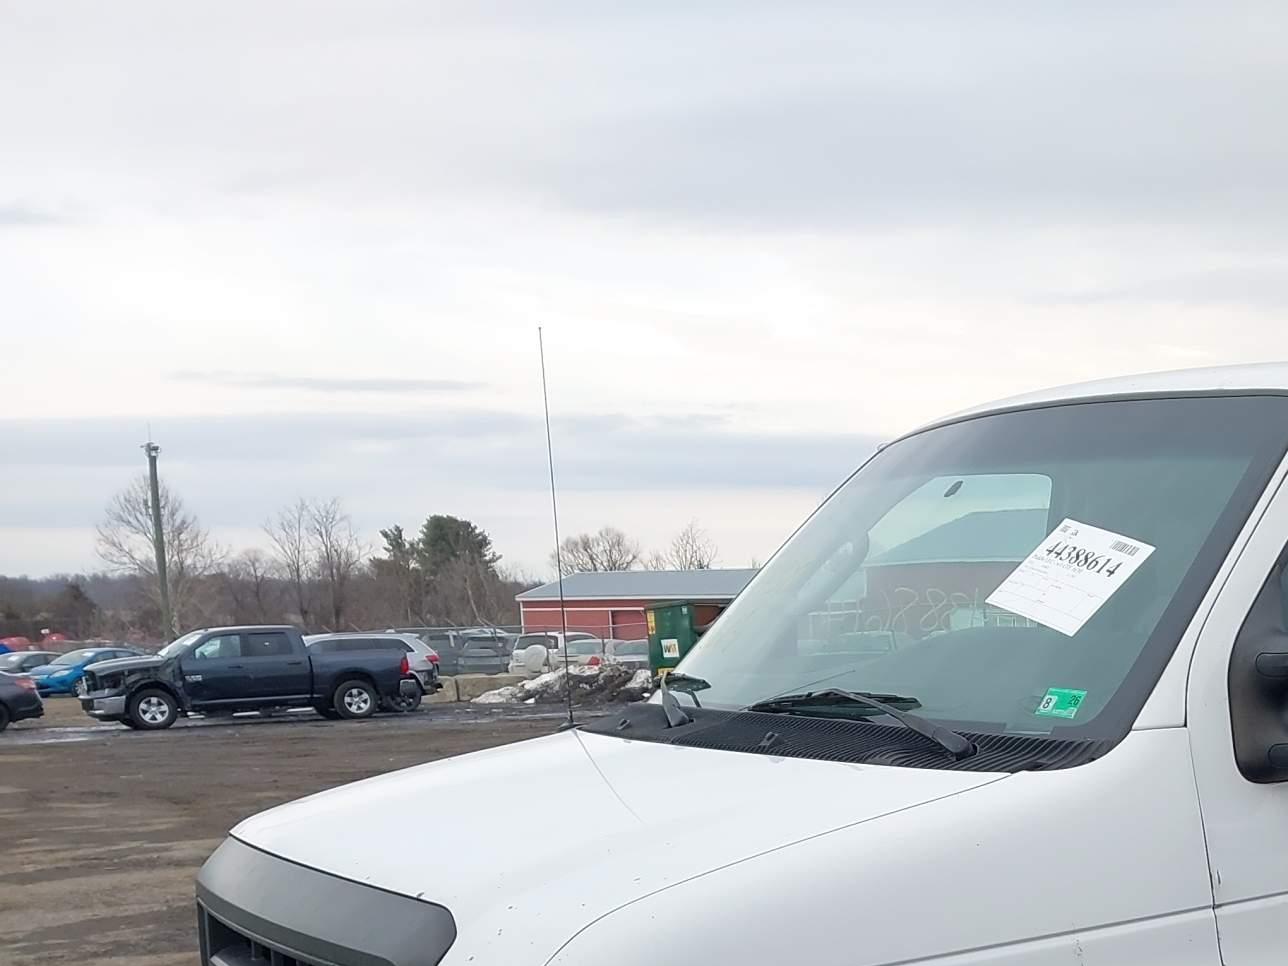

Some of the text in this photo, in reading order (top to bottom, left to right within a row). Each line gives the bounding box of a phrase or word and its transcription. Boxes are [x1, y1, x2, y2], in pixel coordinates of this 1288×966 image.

[1046, 541, 1122, 578] 44388614
[1042, 694, 1081, 709] 8 26
